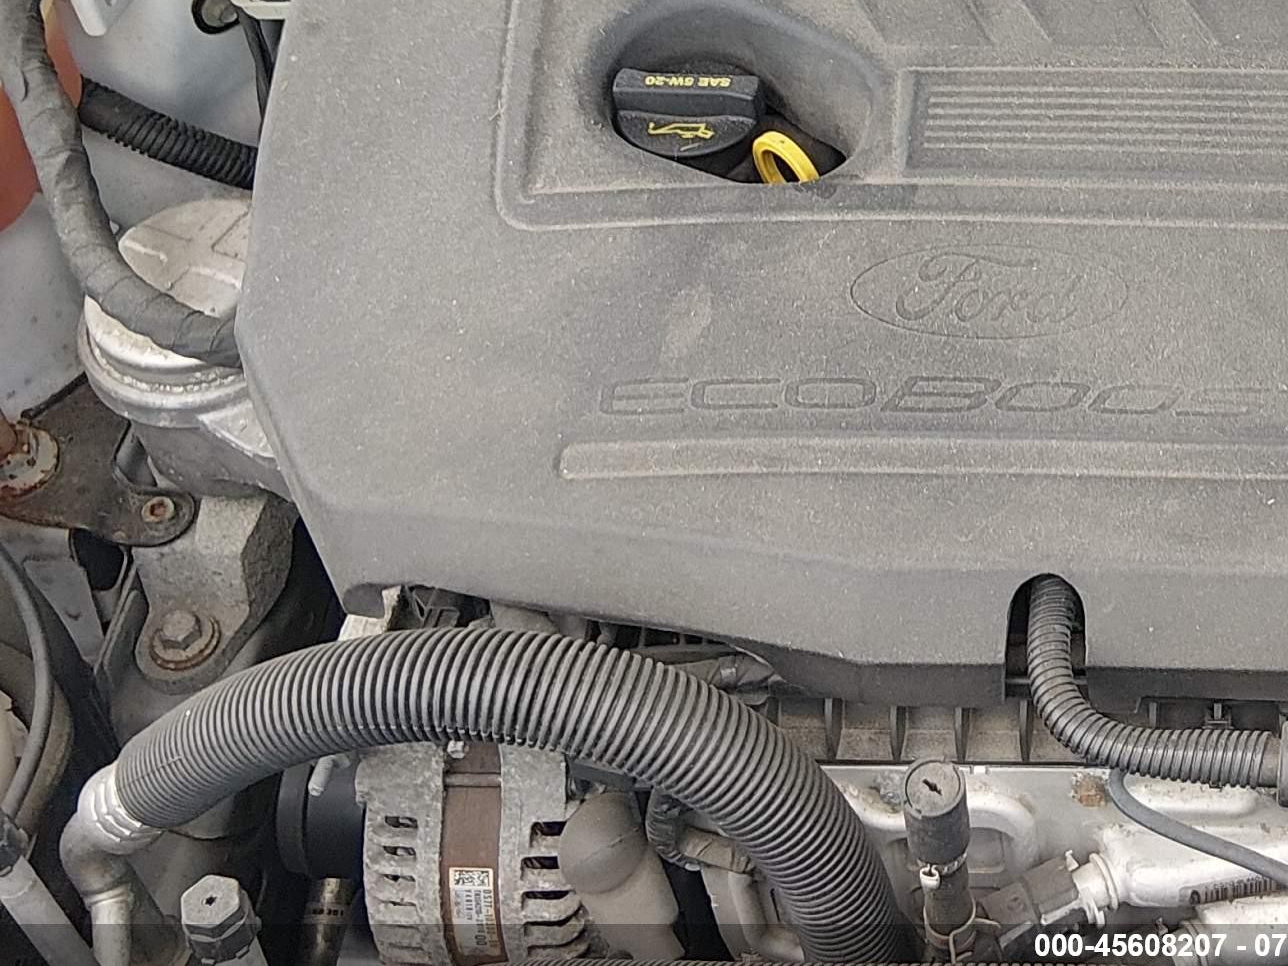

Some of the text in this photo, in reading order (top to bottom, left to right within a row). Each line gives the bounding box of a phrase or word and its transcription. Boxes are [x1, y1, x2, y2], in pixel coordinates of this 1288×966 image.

[644, 75, 731, 87] SAE 5W-20
[894, 251, 1083, 325] Ford
